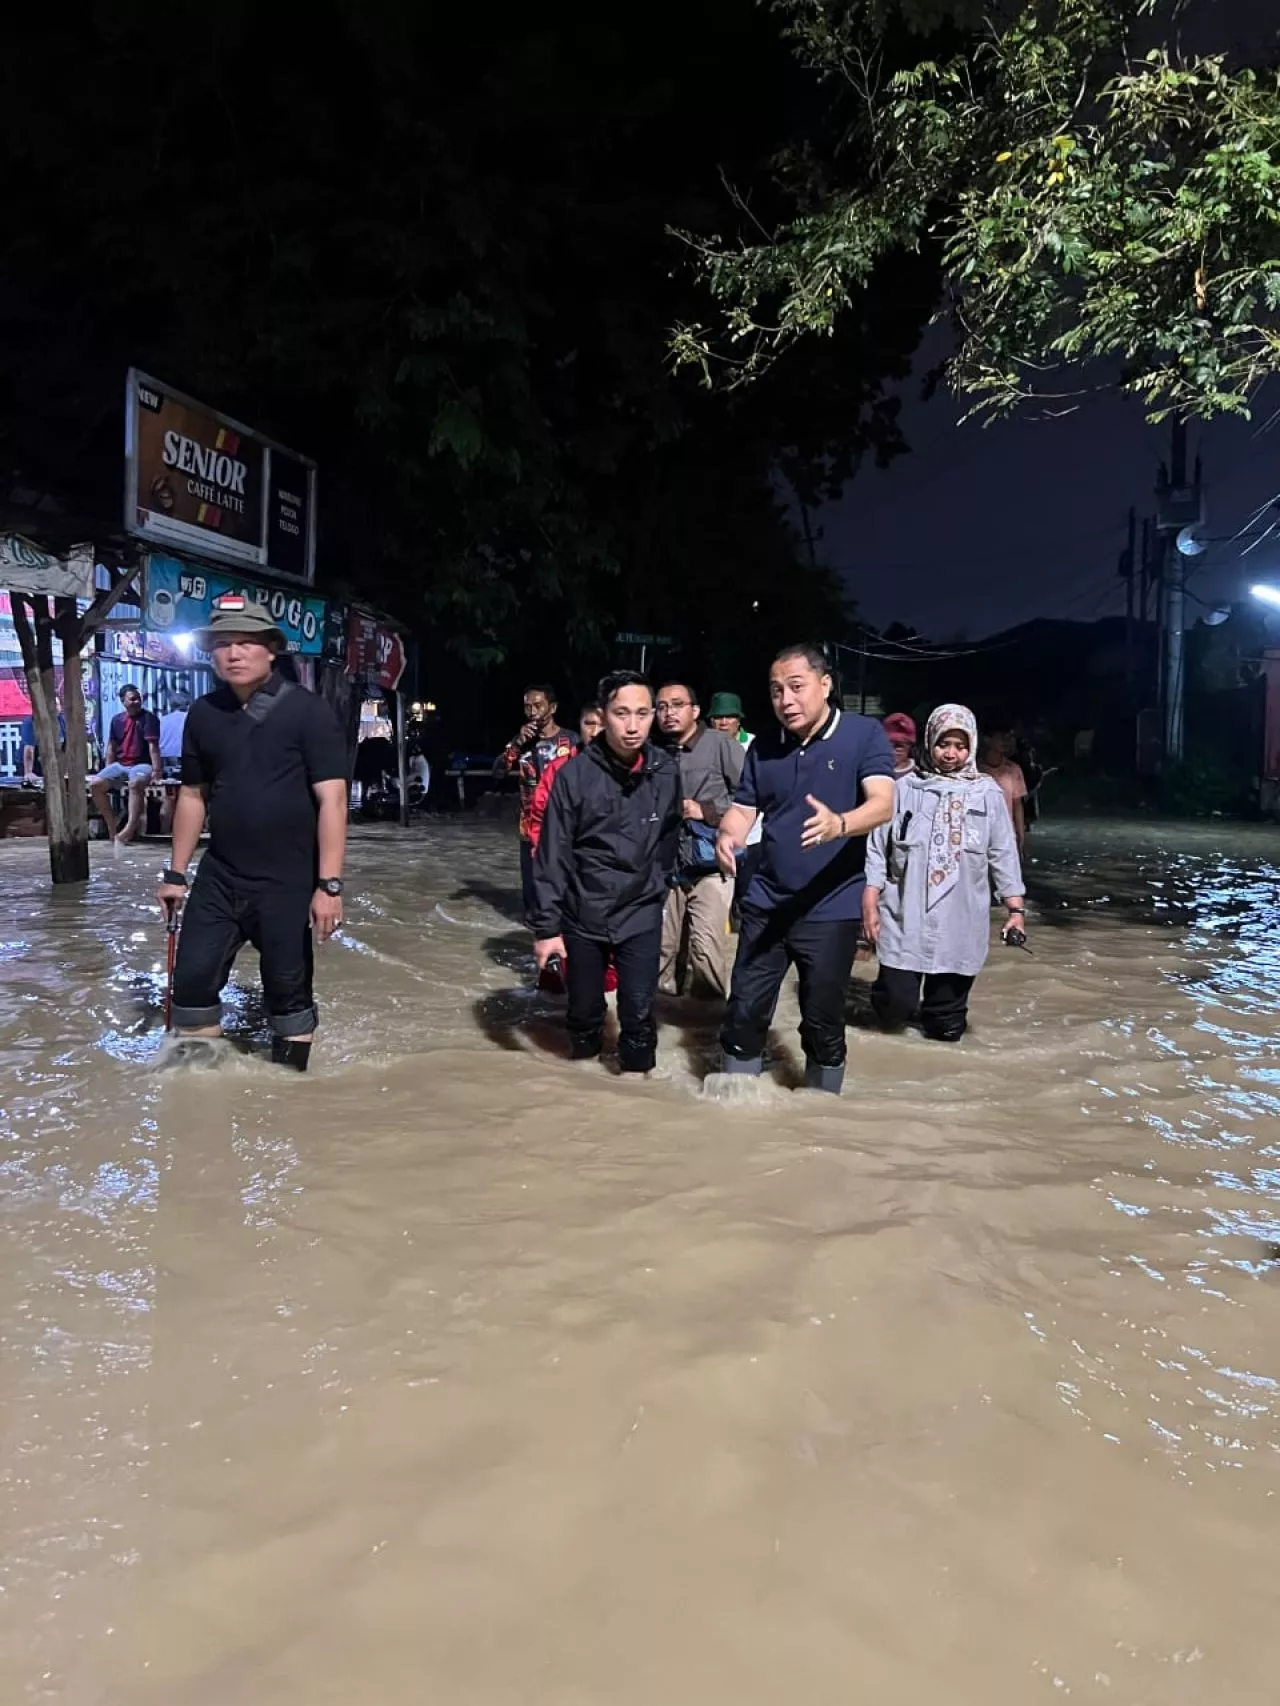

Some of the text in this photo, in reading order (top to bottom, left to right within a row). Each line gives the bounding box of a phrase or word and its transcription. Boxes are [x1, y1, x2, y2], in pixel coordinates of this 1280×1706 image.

[139, 388, 159, 409] NEW
[162, 430, 247, 494] SENIOR
[217, 493, 245, 514] LATTE
